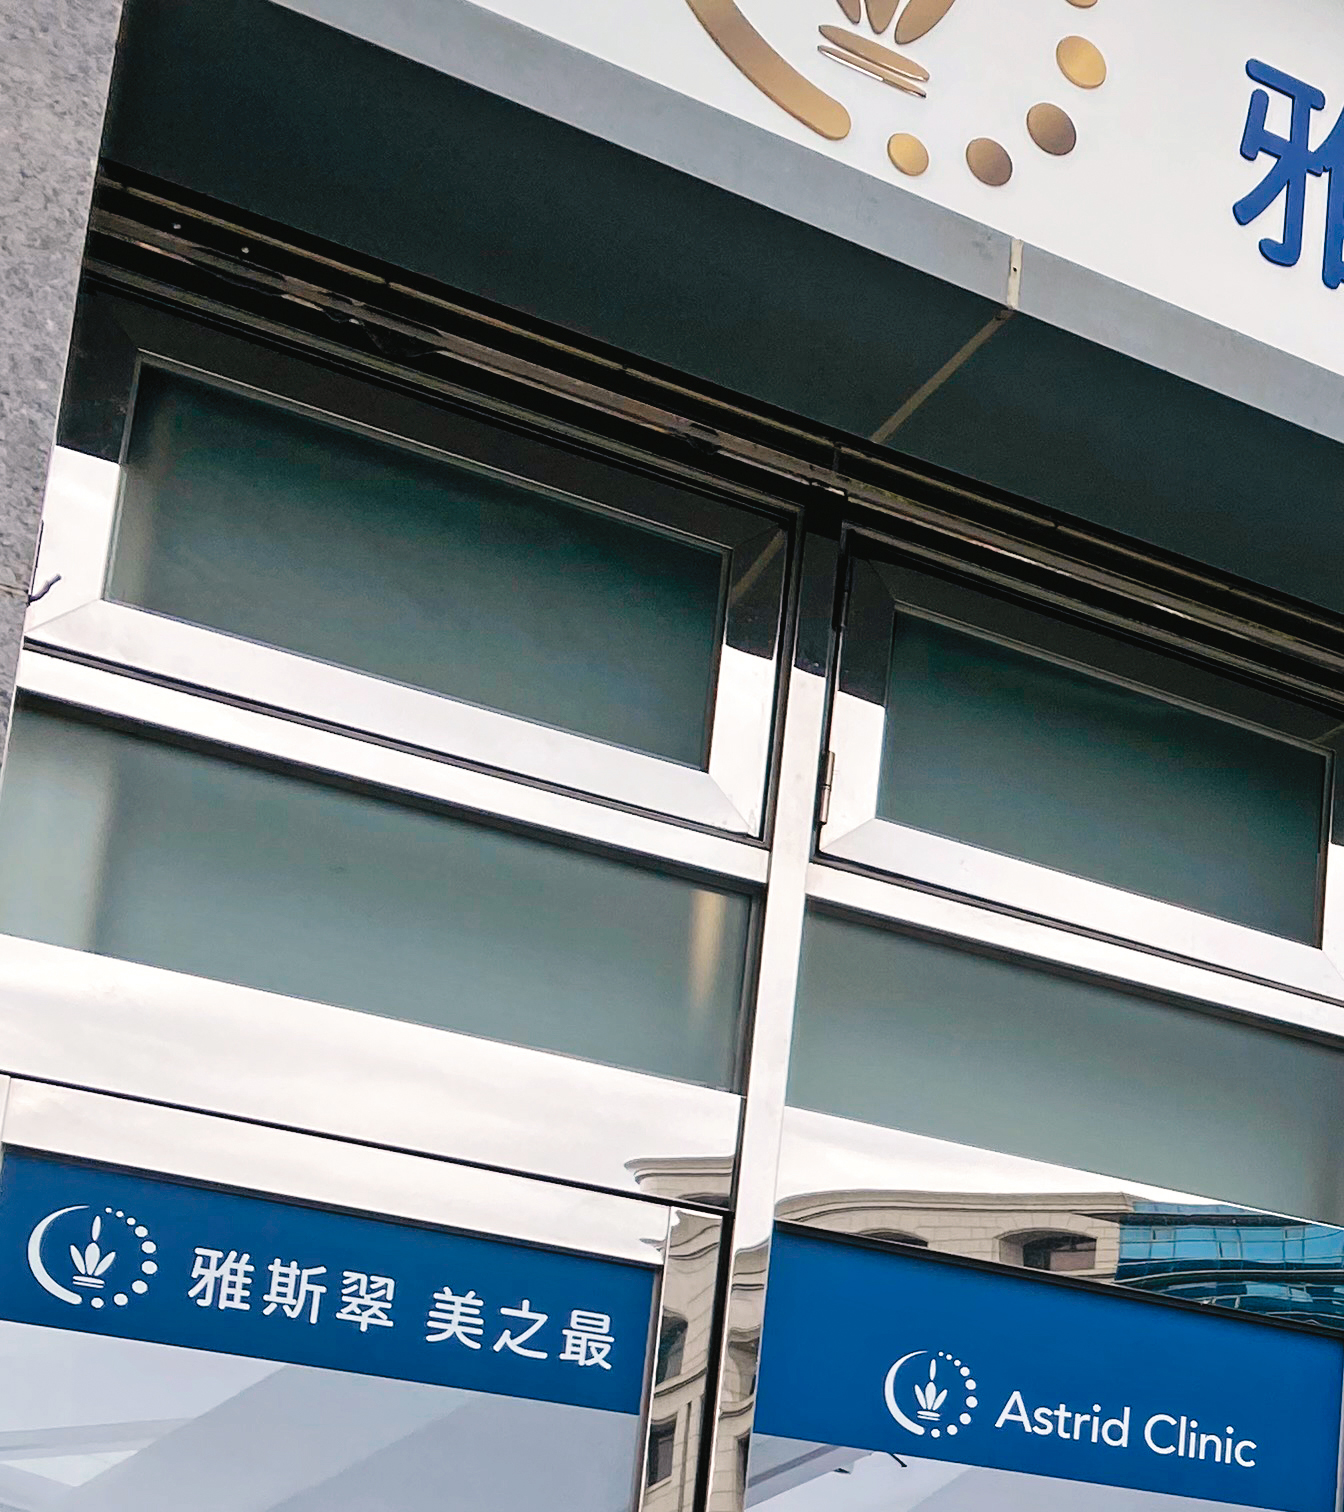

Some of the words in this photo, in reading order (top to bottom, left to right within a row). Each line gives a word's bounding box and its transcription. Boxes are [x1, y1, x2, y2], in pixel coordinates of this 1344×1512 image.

[188, 1246, 396, 1332] 雅斯翠
[425, 1286, 616, 1371] 美之最
[995, 1390, 1131, 1448] Astrid
[1143, 1413, 1258, 1468] Clinic
